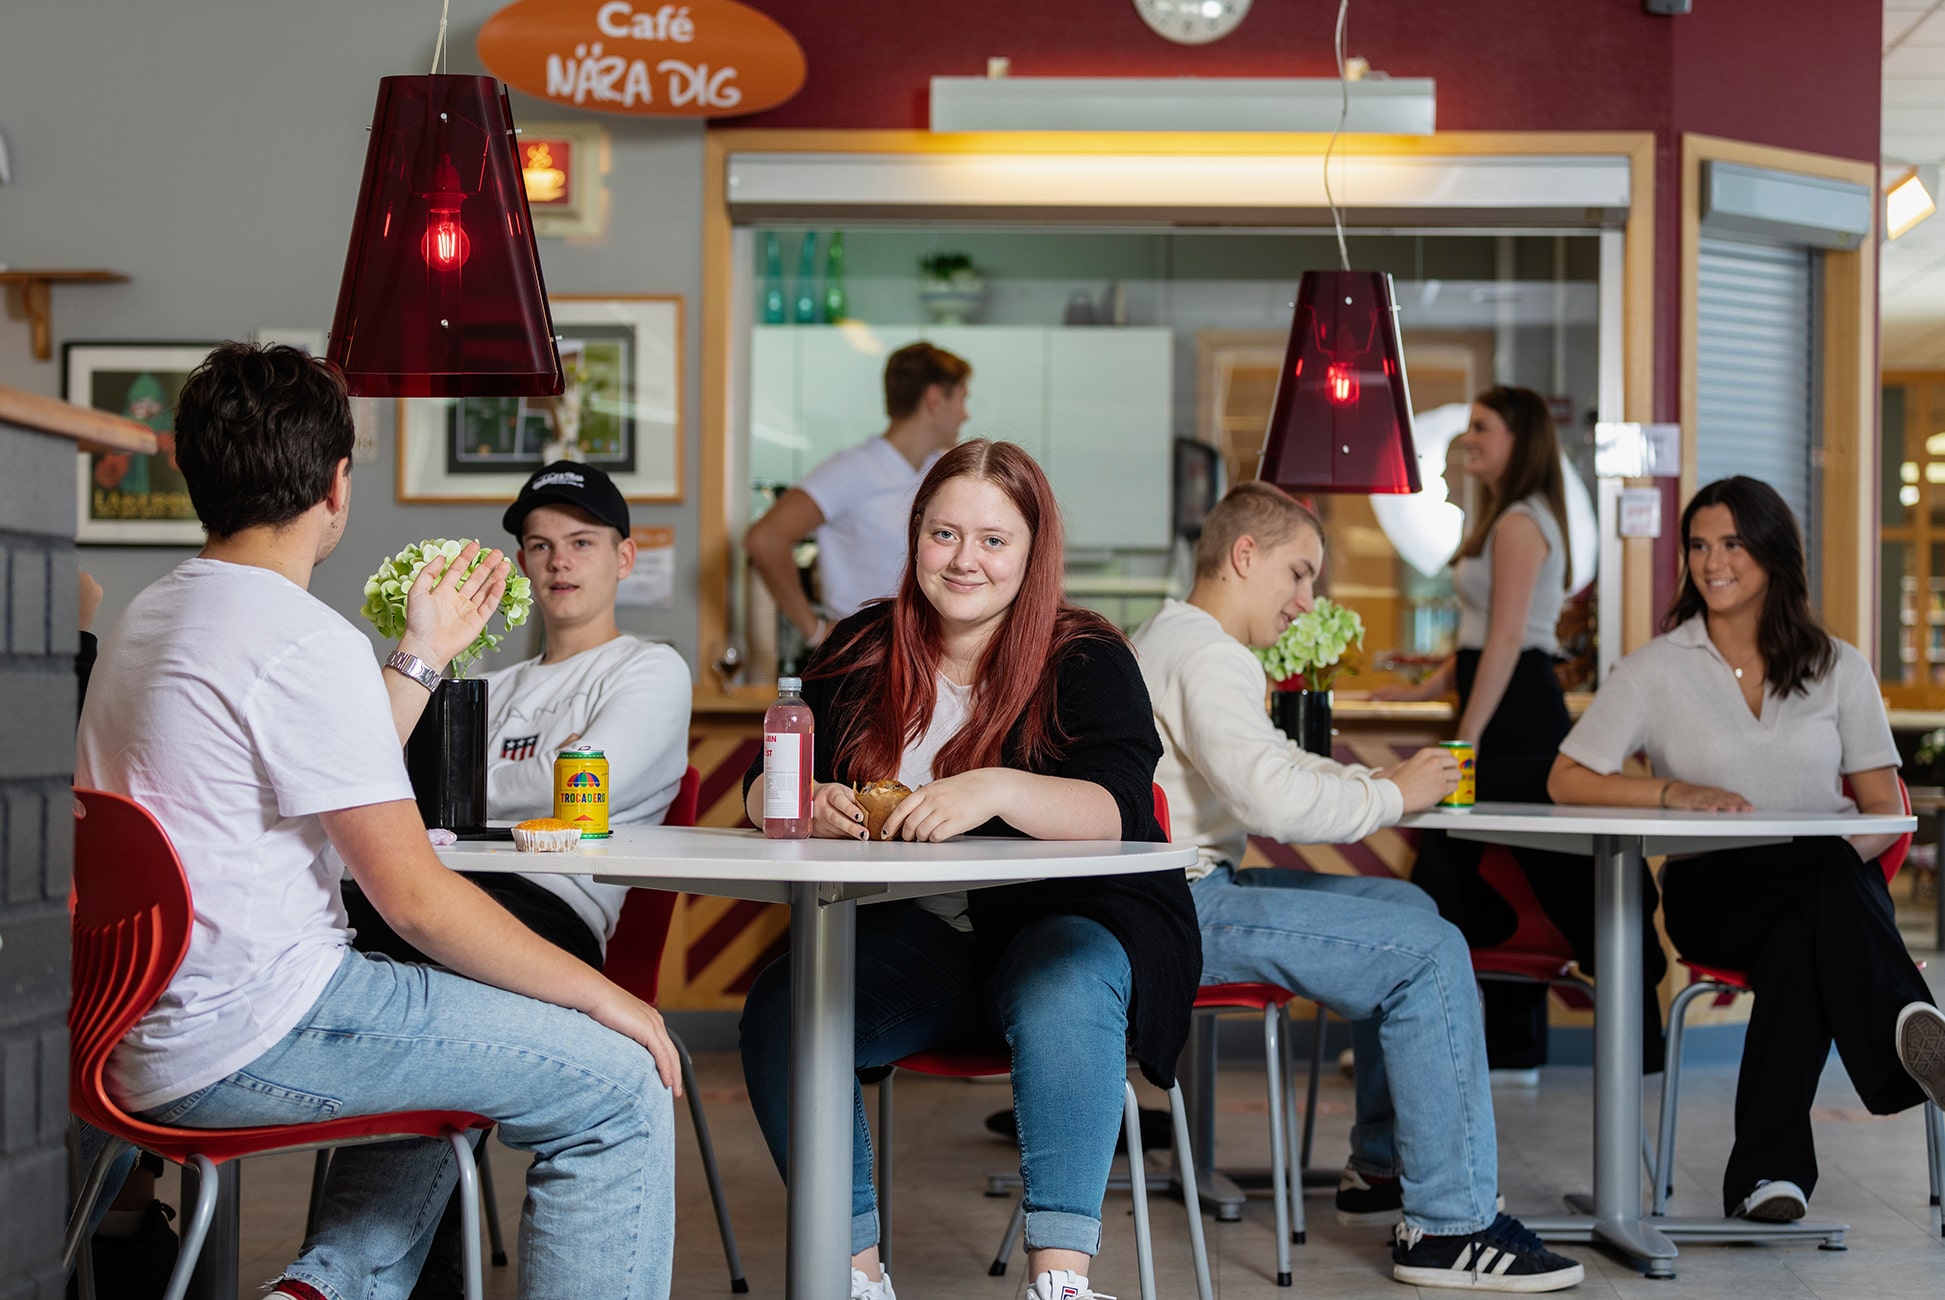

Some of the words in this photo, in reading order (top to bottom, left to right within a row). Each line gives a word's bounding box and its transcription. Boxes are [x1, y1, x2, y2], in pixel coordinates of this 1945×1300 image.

[597, 2, 694, 42] Café
[546, 43, 652, 107] NÄRA
[657, 59, 742, 107] DIG
[561, 793, 605, 803] TROCADERO
